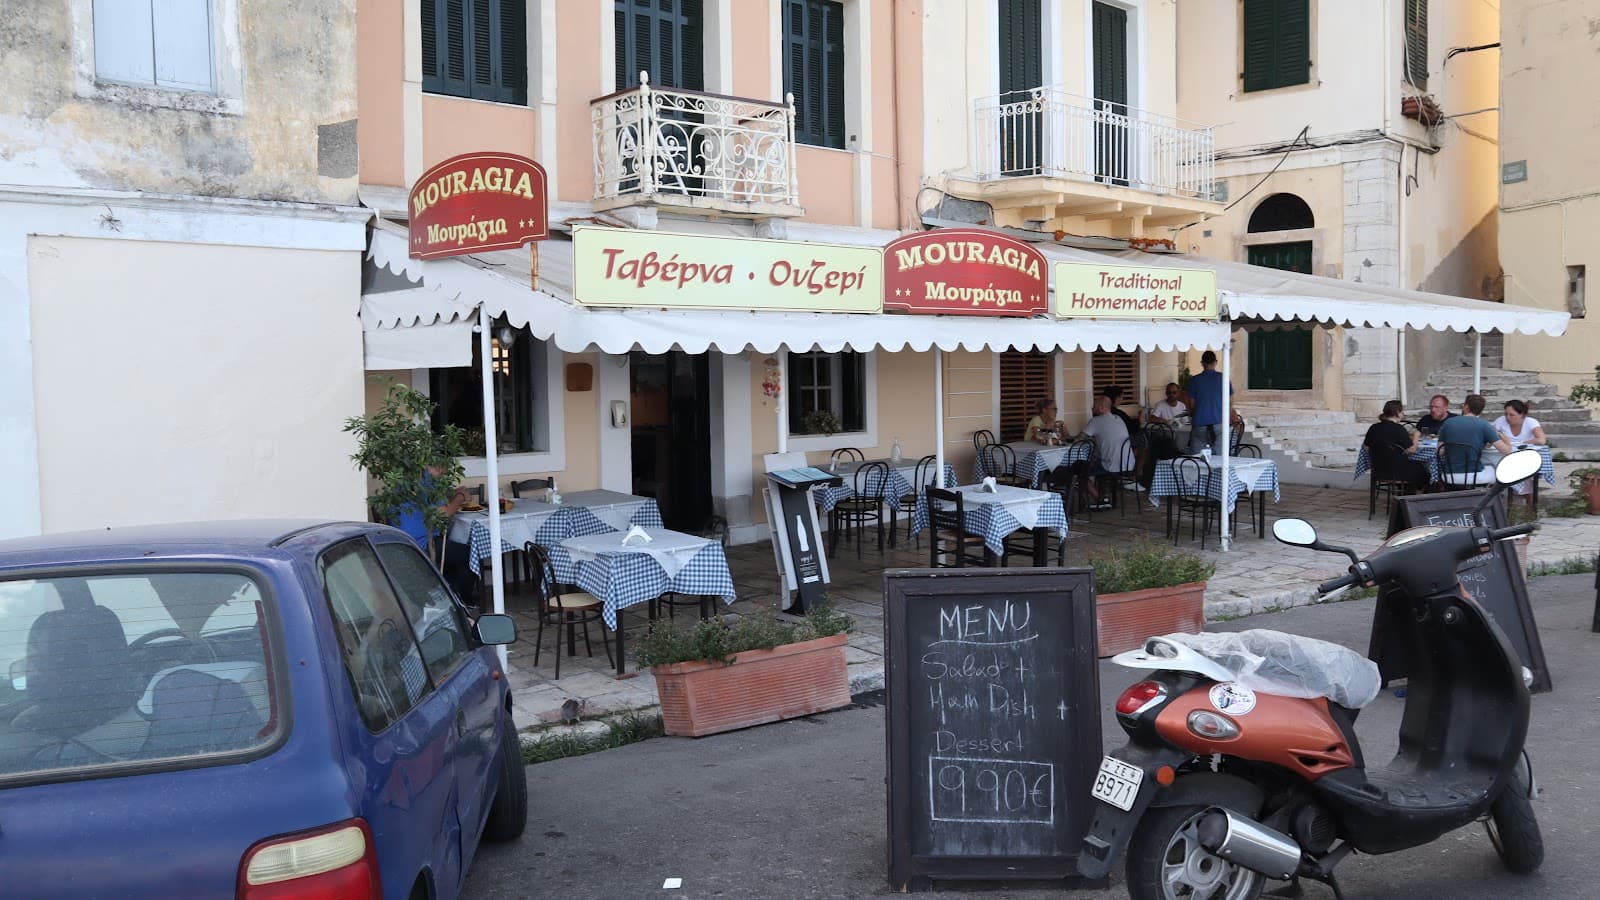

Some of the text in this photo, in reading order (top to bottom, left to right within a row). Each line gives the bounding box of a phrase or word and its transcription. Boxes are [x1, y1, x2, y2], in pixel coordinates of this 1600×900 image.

[413, 166, 534, 218] MOURAGIA
[427, 215, 508, 245] Μουράγια
[602, 248, 867, 295] Ταβέρνα Ουζερί
[895, 241, 1041, 280] MOURAGIA
[924, 281, 1023, 307] Μουράγια
[1099, 271, 1182, 290] Traditional
[1071, 292, 1207, 311] Homemade Food
[939, 600, 1030, 639] MENU
[921, 652, 1001, 679] Salad
[934, 729, 1024, 753] Dessert
[1095, 774, 1132, 805] 8971
